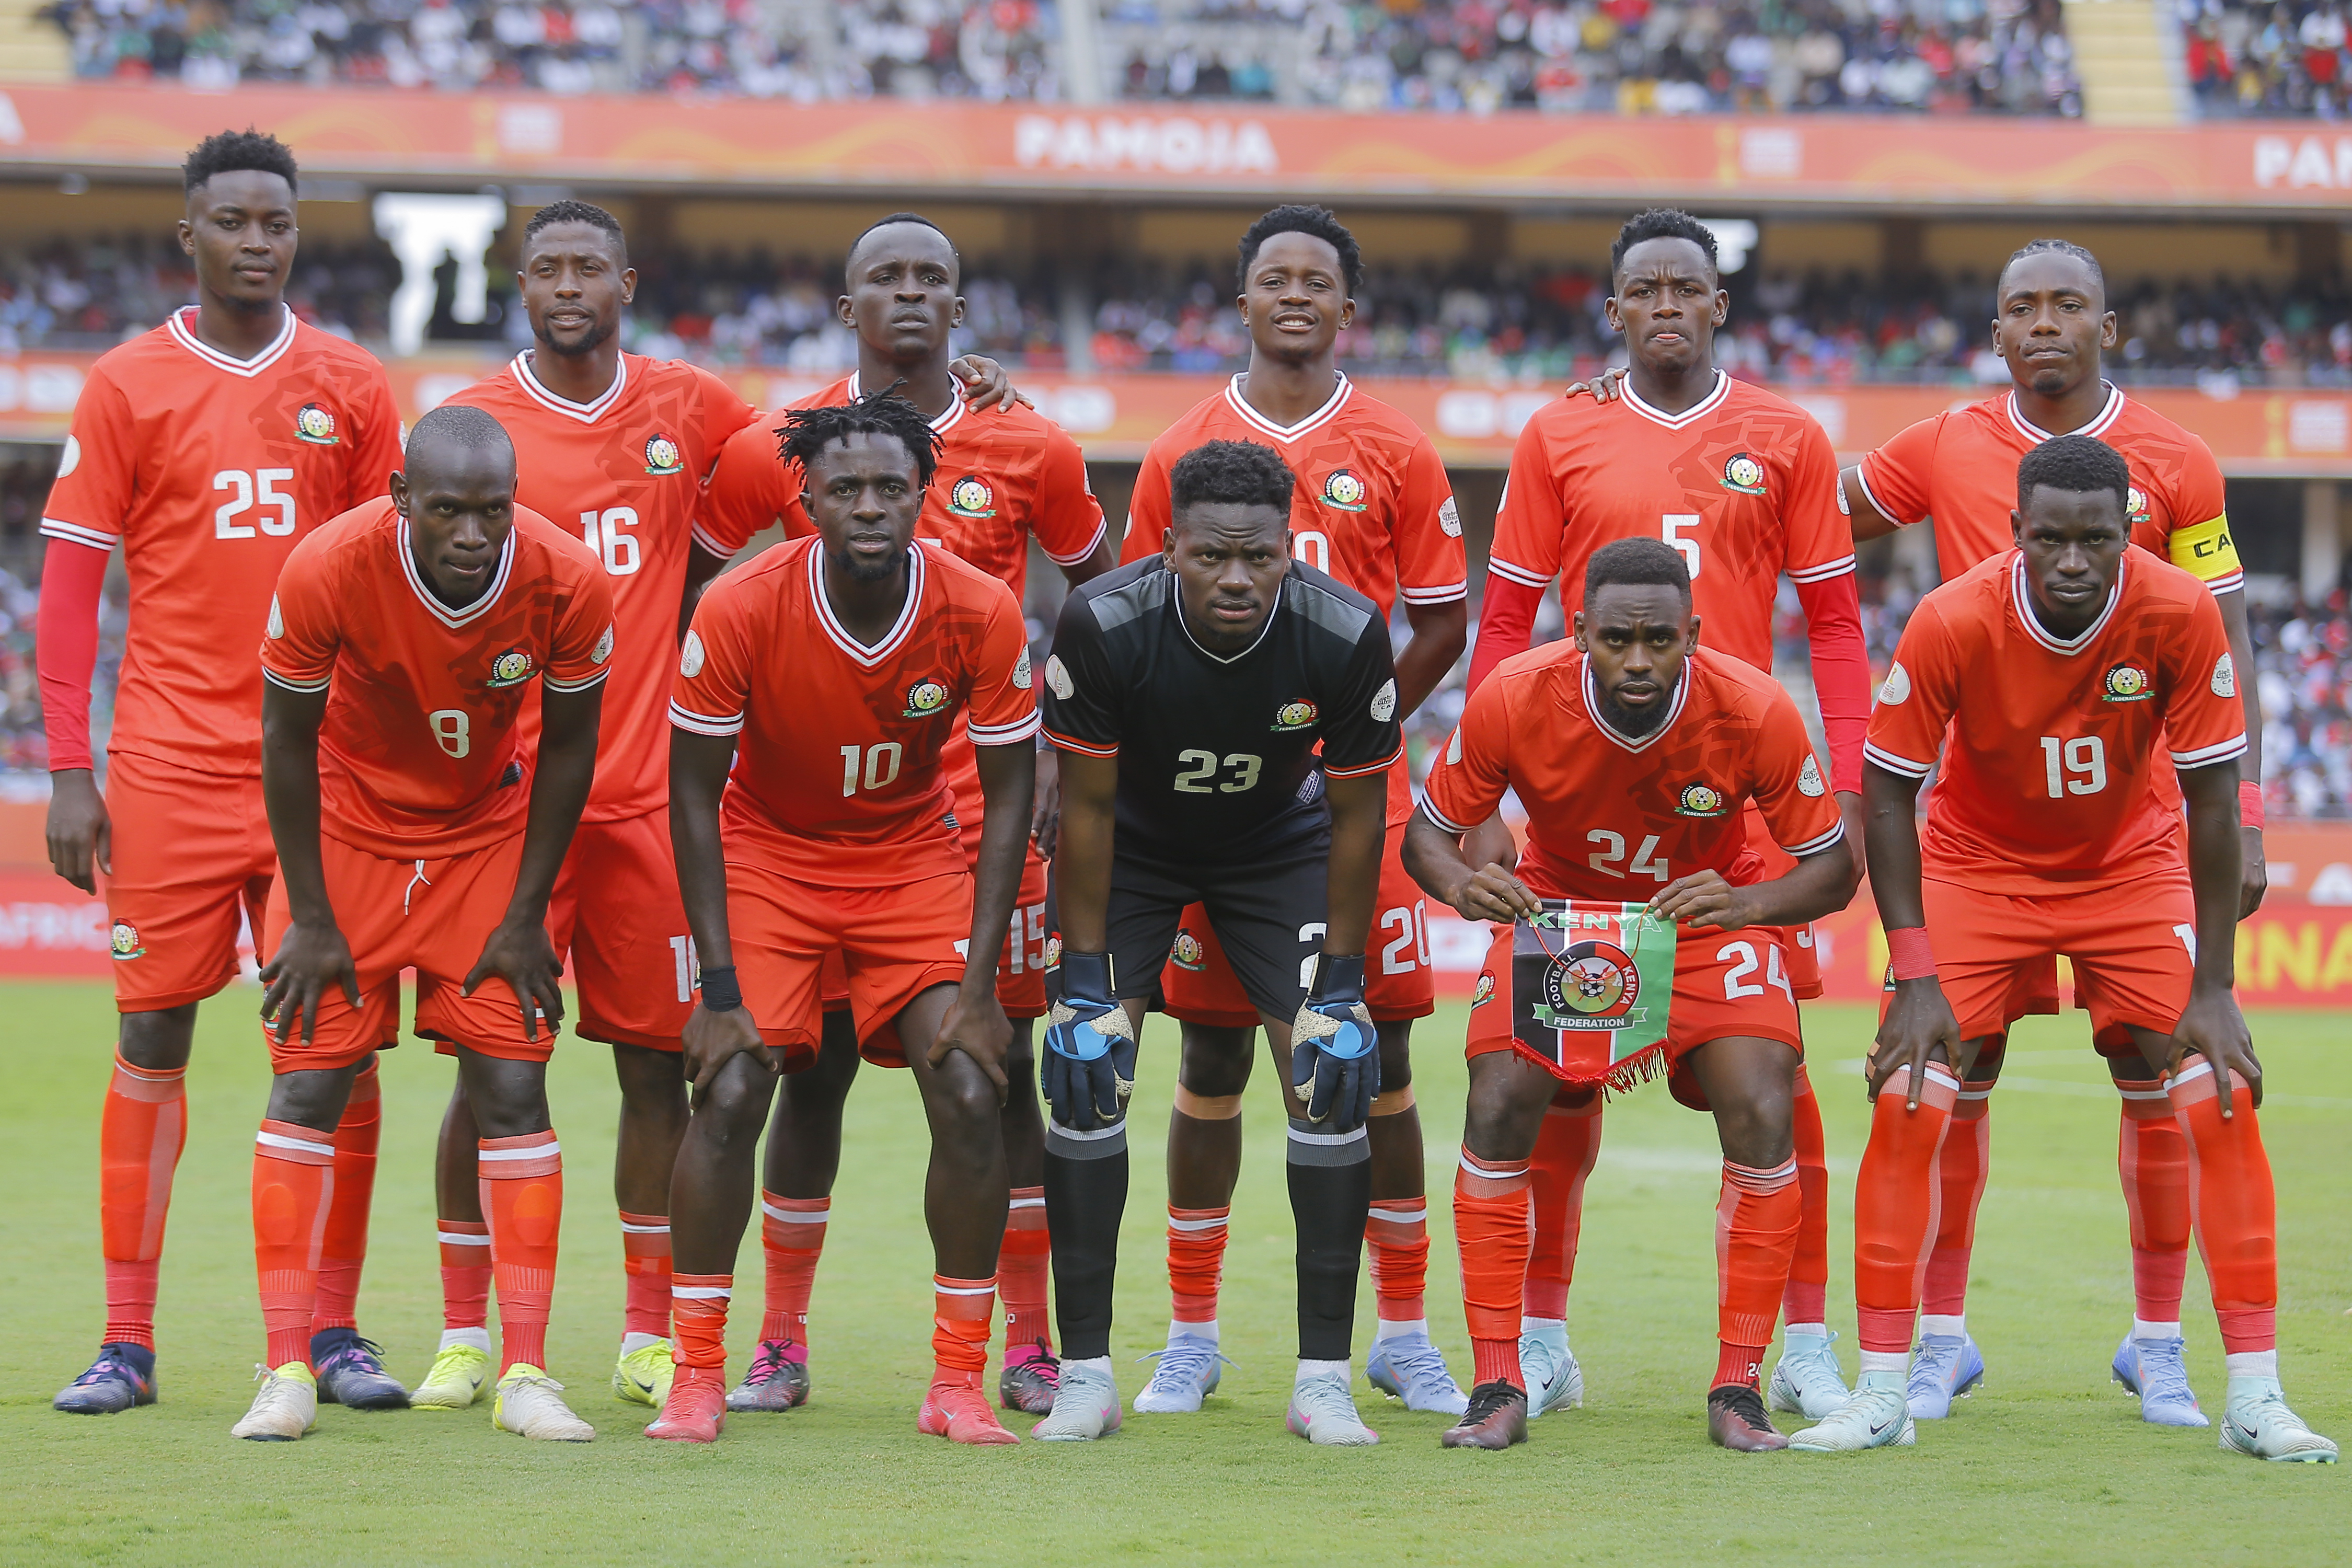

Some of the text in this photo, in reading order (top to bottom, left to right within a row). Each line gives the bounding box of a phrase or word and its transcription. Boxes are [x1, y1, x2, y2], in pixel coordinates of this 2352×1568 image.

[1016, 114, 1279, 174] PAMOJA
[1725, 456, 1738, 480] FOOTBALL
[953, 479, 965, 505] FOOTBALL
[1326, 472, 1339, 497] FOOTBALL
[1727, 484, 1758, 494] FEDERATION
[213, 468, 296, 539] 25
[954, 509, 987, 517] FEDERATION
[1326, 500, 1358, 511] FEDERATION
[580, 506, 641, 575] 16
[1293, 531, 1329, 576] 0
[1662, 514, 1700, 581] 5
[493, 655, 504, 679] FOOTBALL
[495, 676, 527, 687] FEDERATION
[2106, 668, 2116, 694] FOOTBALL
[908, 684, 919, 709] FOOTBALL
[912, 705, 944, 717] FEDERATION
[1276, 704, 1288, 725] FOOTBALL
[429, 709, 469, 758] 8
[1278, 722, 1312, 731] FEDERATION
[840, 742, 903, 798] 10
[1174, 749, 1262, 793] 23
[2040, 735, 2107, 799] 19
[1681, 785, 1693, 808] FOOTBALL
[1587, 829, 1669, 882] 24
[1528, 912, 1663, 932] KENYA
[1010, 904, 1045, 974] 15
[1380, 899, 1430, 975] 20
[1549, 953, 1576, 1009] FOOTBALL
[1619, 965, 1635, 1005] KENYA
[1716, 941, 1795, 1006] 24
[1553, 1017, 1625, 1028] FEDERATION
